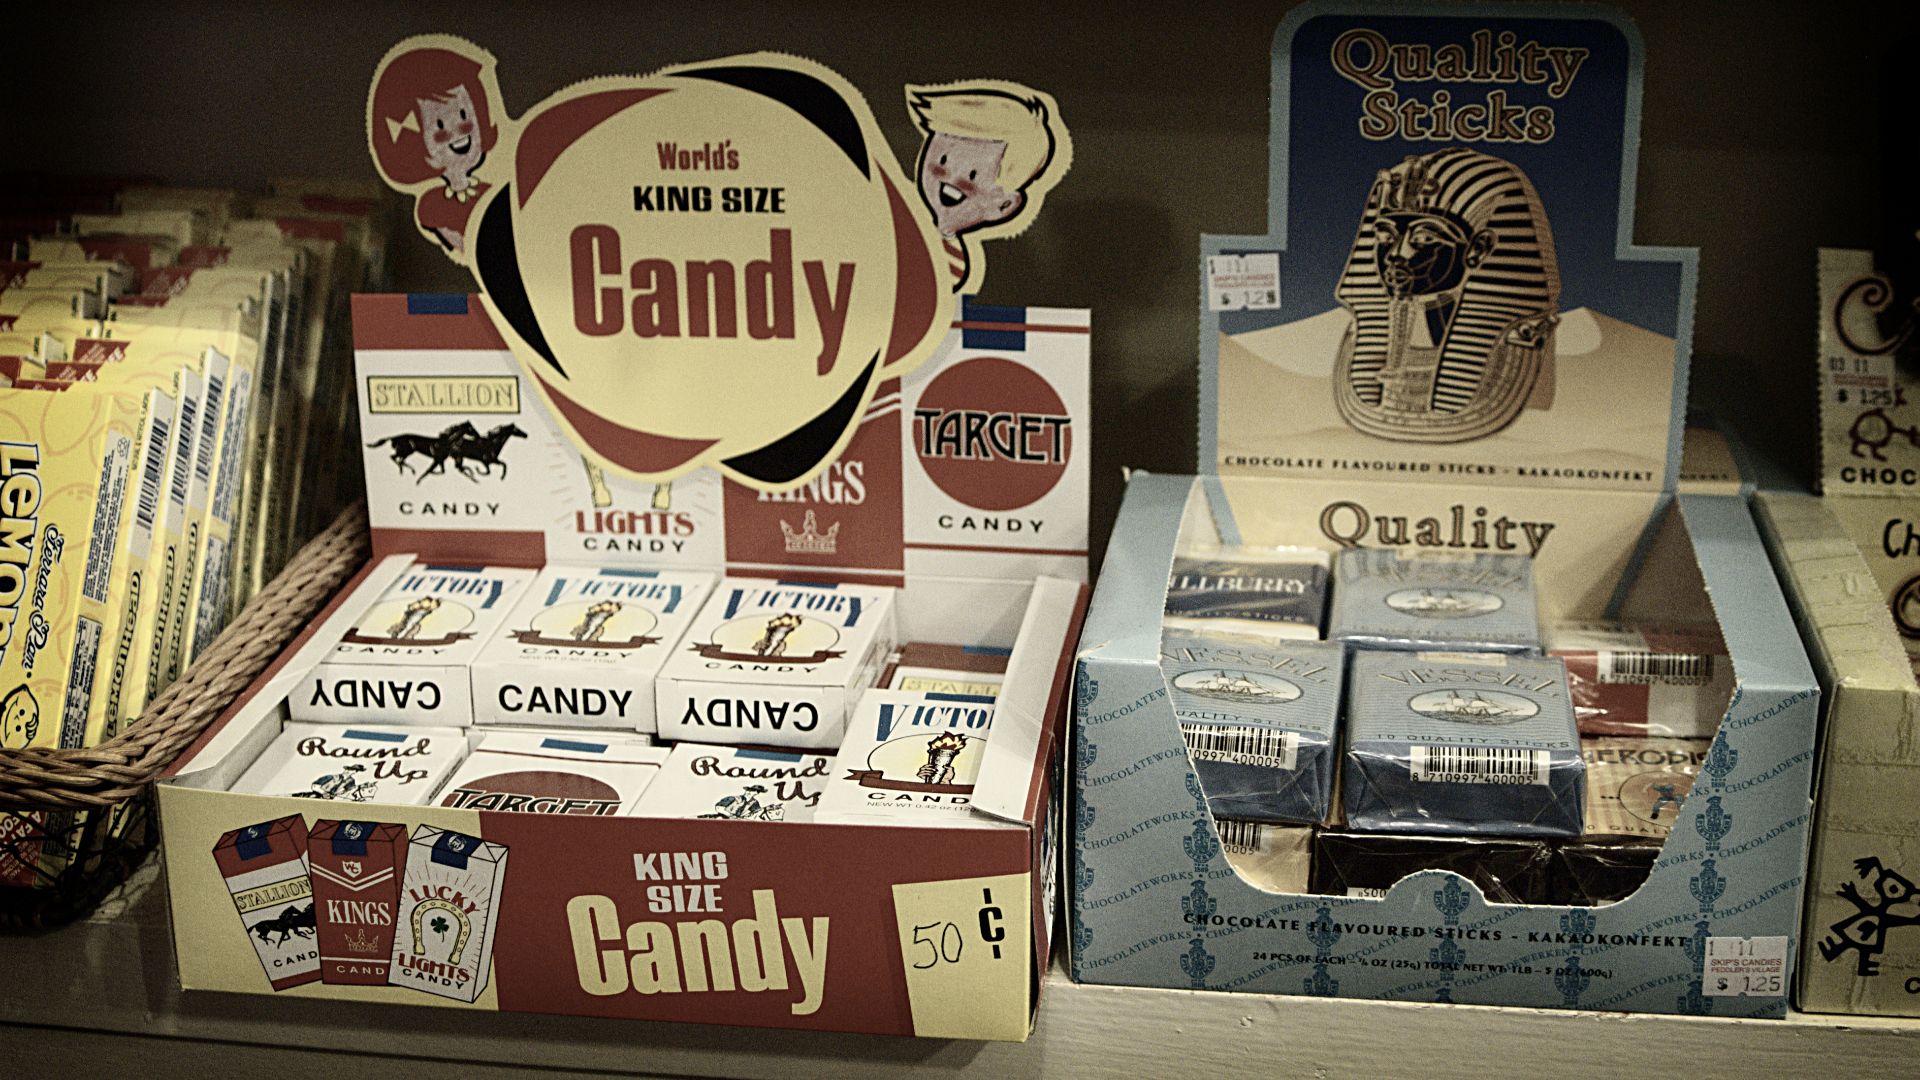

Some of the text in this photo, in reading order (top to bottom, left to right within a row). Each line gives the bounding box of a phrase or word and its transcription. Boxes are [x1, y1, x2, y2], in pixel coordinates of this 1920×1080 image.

[1331, 28, 1590, 98] Quality
[1360, 90, 1556, 142] Sticks
[657, 140, 740, 170] World's
[633, 185, 786, 213] KING SIZE
[570, 224, 857, 376] Candy
[375, 383, 515, 408] STALLION
[914, 409, 1072, 465] TARGET
[1225, 455, 1323, 469] CHOCOLATE
[1332, 459, 1431, 473] FLAVOURED
[1439, 463, 1496, 476] STICKS
[1518, 468, 1653, 481] KAKAOKONFEKT
[1840, 466, 1916, 484] CHOC
[757, 460, 867, 505] NGS
[399, 501, 501, 516] CANDY
[576, 509, 695, 537] LIGHTS
[938, 514, 1044, 533] CANDY
[1319, 501, 1555, 557] Quality
[583, 536, 686, 552] CANDY
[32, 522, 65, 614] Ferrara
[544, 578, 682, 614] VICTORY
[723, 588, 862, 627] VICTORY
[522, 647, 633, 658] CANDY
[705, 662, 818, 674] CANDY
[310, 679, 441, 710] CANDY
[498, 684, 634, 718] CANDY
[681, 697, 818, 732] CANDY
[296, 737, 431, 758] Round
[1377, 733, 1571, 750] 10 QUALITY STICKS
[373, 760, 428, 785] Up
[690, 756, 830, 780] Round
[1233, 753, 1280, 769] 400005
[1412, 771, 1535, 785] 8 710997 400005
[448, 788, 622, 816] TARGET
[1691, 788, 1709, 797] KS
[1083, 810, 1195, 850] CHOCOLATEWORKS
[633, 851, 729, 881] KING
[236, 879, 311, 911] STALLION
[409, 886, 480, 914] LUCKY
[647, 884, 723, 913] SIZE
[1082, 871, 1194, 911] CHOCOLATEWORKS
[327, 899, 391, 926] KINGS
[1183, 912, 1300, 931] CHOCOLATE
[1309, 921, 1426, 939] FLAVOURED
[1434, 927, 1502, 941] STICKS
[1528, 931, 1688, 948] KAKAOKONFEKT
[565, 889, 830, 1016] Candy
[912, 921, 963, 968] 50
[1081, 931, 1192, 970] CHOCOLATEWORKS
[273, 950, 318, 968] CAND
[336, 965, 385, 975] CAND
[398, 953, 470, 983] LIGHTS
[1252, 952, 1267, 960] 24
[1270, 953, 1293, 962] PCS
[1298, 954, 1312, 963] OF
[1315, 956, 1346, 965] EACH
[1371, 958, 1387, 968] OZ
[1391, 959, 1421, 971] (25g)
[1425, 962, 1460, 972] TOTAL
[1463, 964, 1483, 973] NET
[1555, 967, 1572, 977] OZ
[1711, 959, 1782, 967] SKIP'S CANDIES
[402, 968, 465, 990] CANDY
[1717, 975, 1781, 992] $ 1.25
